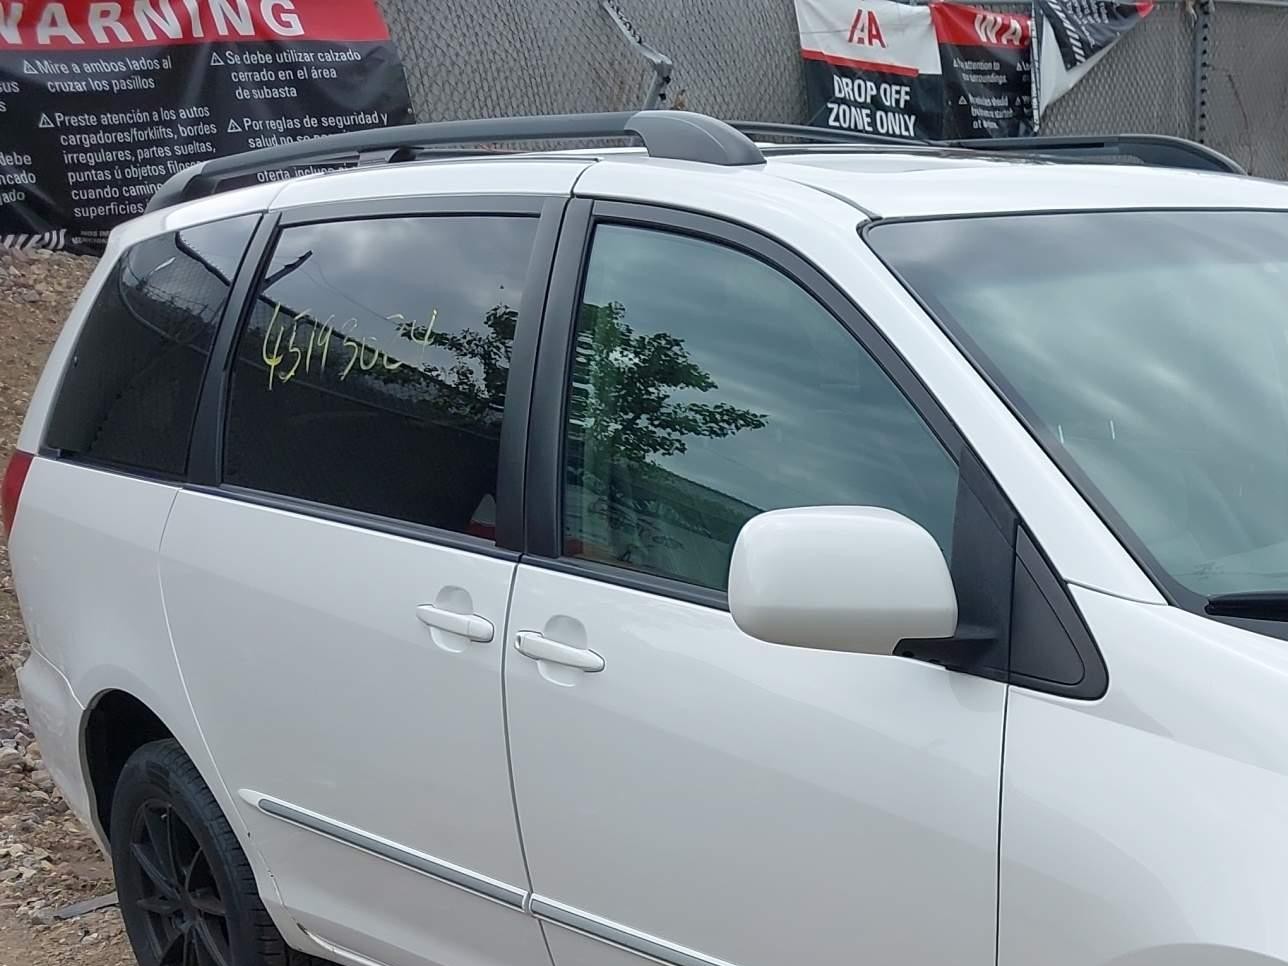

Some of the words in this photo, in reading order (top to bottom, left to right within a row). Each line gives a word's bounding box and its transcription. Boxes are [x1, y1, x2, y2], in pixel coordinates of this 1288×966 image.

[974, 14, 1031, 45] WA
[37, 59, 69, 74] Mire
[72, 65, 80, 74] a
[83, 60, 126, 73] ambos
[127, 57, 159, 71] lados
[162, 57, 172, 69] al
[226, 51, 240, 65] Se
[243, 51, 272, 64] debe
[276, 50, 314, 63] utilizar
[317, 48, 361, 62] calzado
[231, 69, 275, 82] cerrado
[278, 70, 294, 81] en
[297, 68, 308, 80] el
[311, 66, 337, 79] área
[48, 80, 87, 93] cruzar
[88, 78, 109, 92] los
[112, 75, 155, 94] pasillos
[236, 87, 250, 100] de
[252, 86, 297, 99] subasta
[833, 74, 877, 104] DROP
[880, 83, 911, 109] OFF
[55, 112, 98, 127] Preste
[100, 108, 150, 125] atención
[152, 111, 159, 122] a
[160, 107, 176, 121] los
[179, 106, 210, 119] autos
[243, 118, 263, 132] Por
[265, 116, 301, 132] reglas
[303, 115, 318, 128] de
[321, 111, 379, 130] seguridad
[379, 113, 388, 126] y
[827, 102, 873, 132] ZONE
[876, 110, 916, 137] ONLY
[60, 125, 178, 147] cargadores/forklifts,
[178, 121, 217, 137] bordes
[248, 133, 278, 148] salud
[280, 136, 294, 146] no
[63, 148, 135, 165] irregulares,
[137, 146, 172, 162] partes
[174, 140, 216, 155] sueltas,
[68, 168, 111, 186] puntas
[114, 165, 122, 179] ú
[124, 163, 166, 180] objetos
[167, 160, 200, 173] filos
[257, 168, 291, 182] oferta
[0, 188, 25, 206] ado
[71, 185, 119, 200] cuando
[74, 200, 145, 219] superficies
